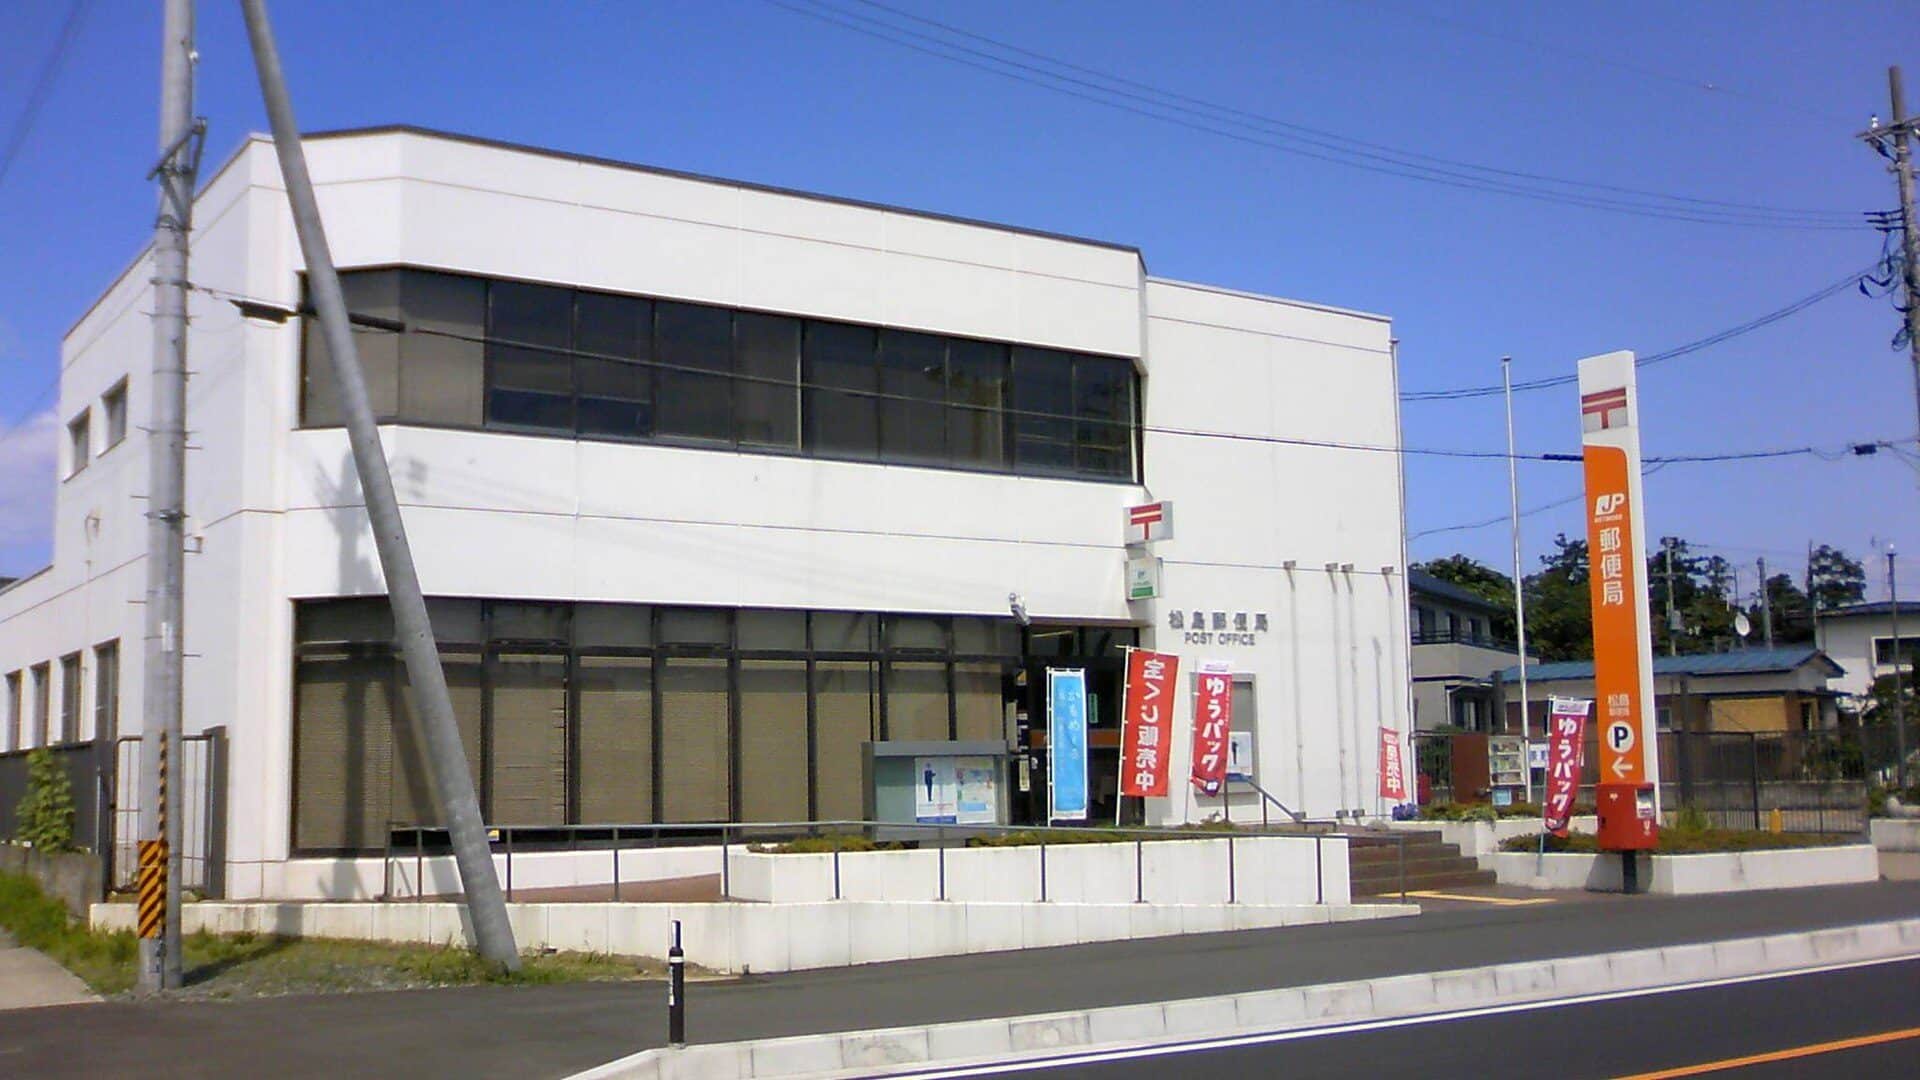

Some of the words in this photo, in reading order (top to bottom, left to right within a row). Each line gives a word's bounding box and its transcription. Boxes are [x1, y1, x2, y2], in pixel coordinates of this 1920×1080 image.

[1600, 527, 1623, 606] 郵便局
[1168, 609, 1268, 632] 松島郵便局
[1184, 632, 1213, 644] POST
[1218, 633, 1256, 645] OFFICE
[1202, 678, 1225, 772] ゆうパック
[1613, 726, 1629, 748] P
[1553, 718, 1577, 812] ゆうパック
